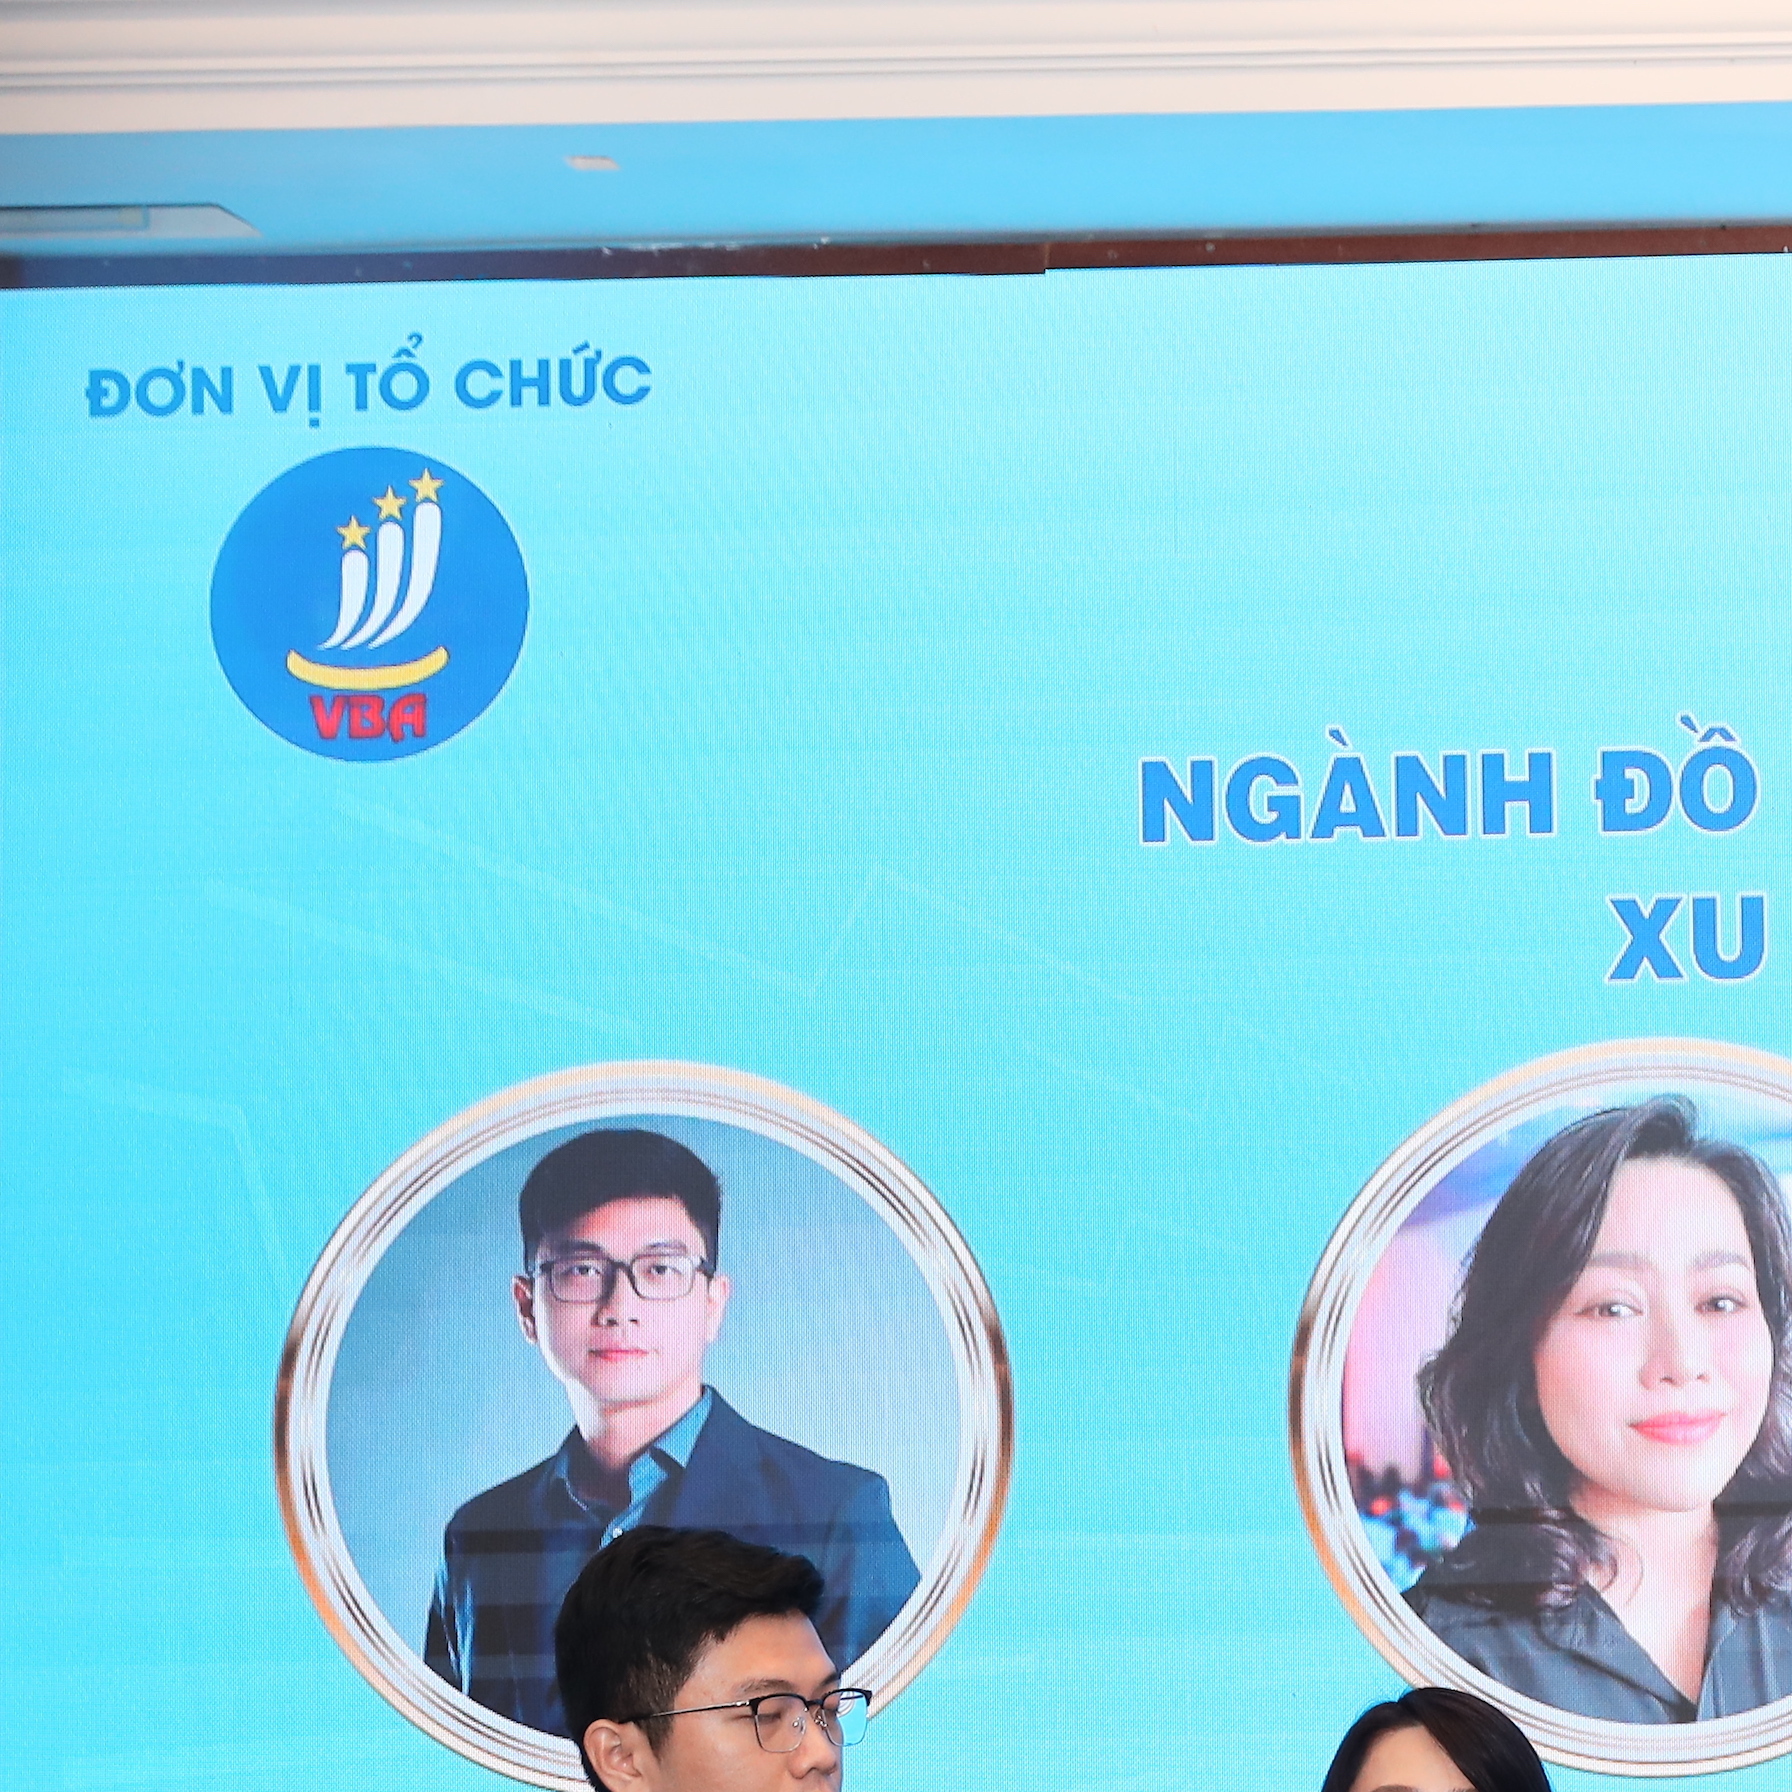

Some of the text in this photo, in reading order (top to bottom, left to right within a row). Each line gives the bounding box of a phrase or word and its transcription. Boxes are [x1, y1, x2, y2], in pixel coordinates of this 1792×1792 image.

[86, 332, 653, 427] ĐƠN VỊ TỔ CHỨC
[309, 693, 427, 742] VBA
[1140, 728, 1553, 843] NGÀNH
[1594, 712, 1759, 834] ĐỒ
[1606, 893, 1767, 985] XU
